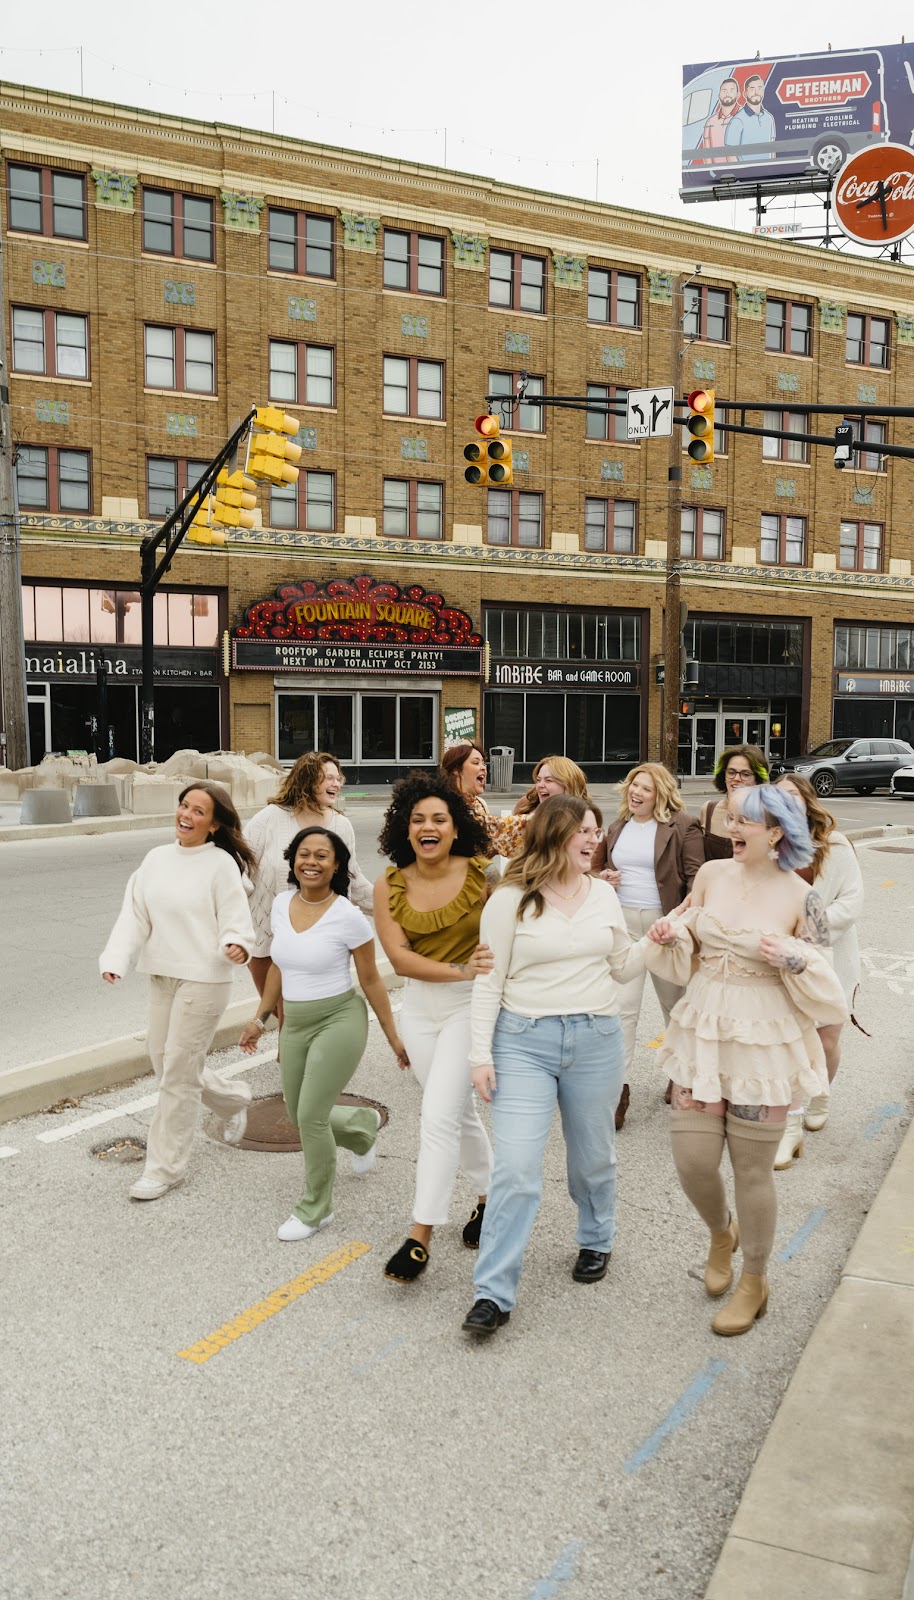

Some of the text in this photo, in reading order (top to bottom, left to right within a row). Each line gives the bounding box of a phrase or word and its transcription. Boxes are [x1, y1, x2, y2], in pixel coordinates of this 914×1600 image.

[785, 78, 861, 97] PETERMAN
[804, 95, 841, 103] BROTHERS
[825, 114, 853, 122] COOLING
[838, 171, 914, 205] CocaCol
[754, 225, 799, 234] FOXPOINT
[628, 426, 648, 434] ONLY
[295, 601, 433, 629] FOUNTAIN SQUARE
[275, 647, 443, 660] ROOFTOP GARDEN ECLIPSE PARTY!
[283, 657, 436, 670] NEXT INDY TOTALITY OCT 2153
[547, 669, 562, 681] BAR
[565, 671, 578, 682] and
[580, 670, 603, 682] GAME
[605, 671, 631, 683] ROOM
